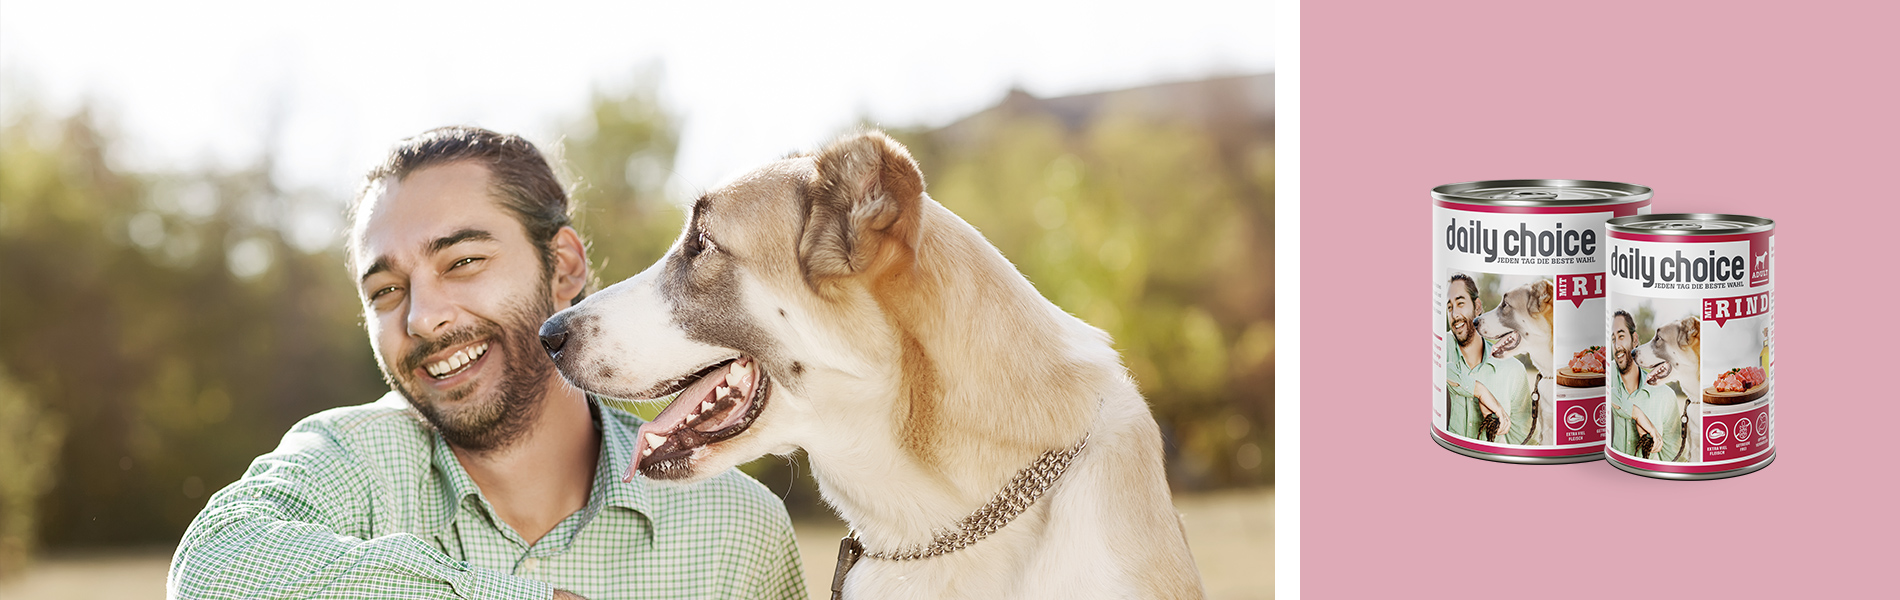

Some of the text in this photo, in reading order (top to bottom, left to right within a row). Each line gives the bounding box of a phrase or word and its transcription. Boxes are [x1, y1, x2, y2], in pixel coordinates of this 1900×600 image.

[1446, 218, 1596, 263] daily choice
[1551, 257, 1575, 265] BESTE
[1576, 256, 1596, 264] WAHL
[1611, 245, 1745, 288] daily choice
[1559, 277, 1567, 297] MIT
[1704, 300, 1712, 319] MIT
[1715, 293, 1768, 319] RIND
